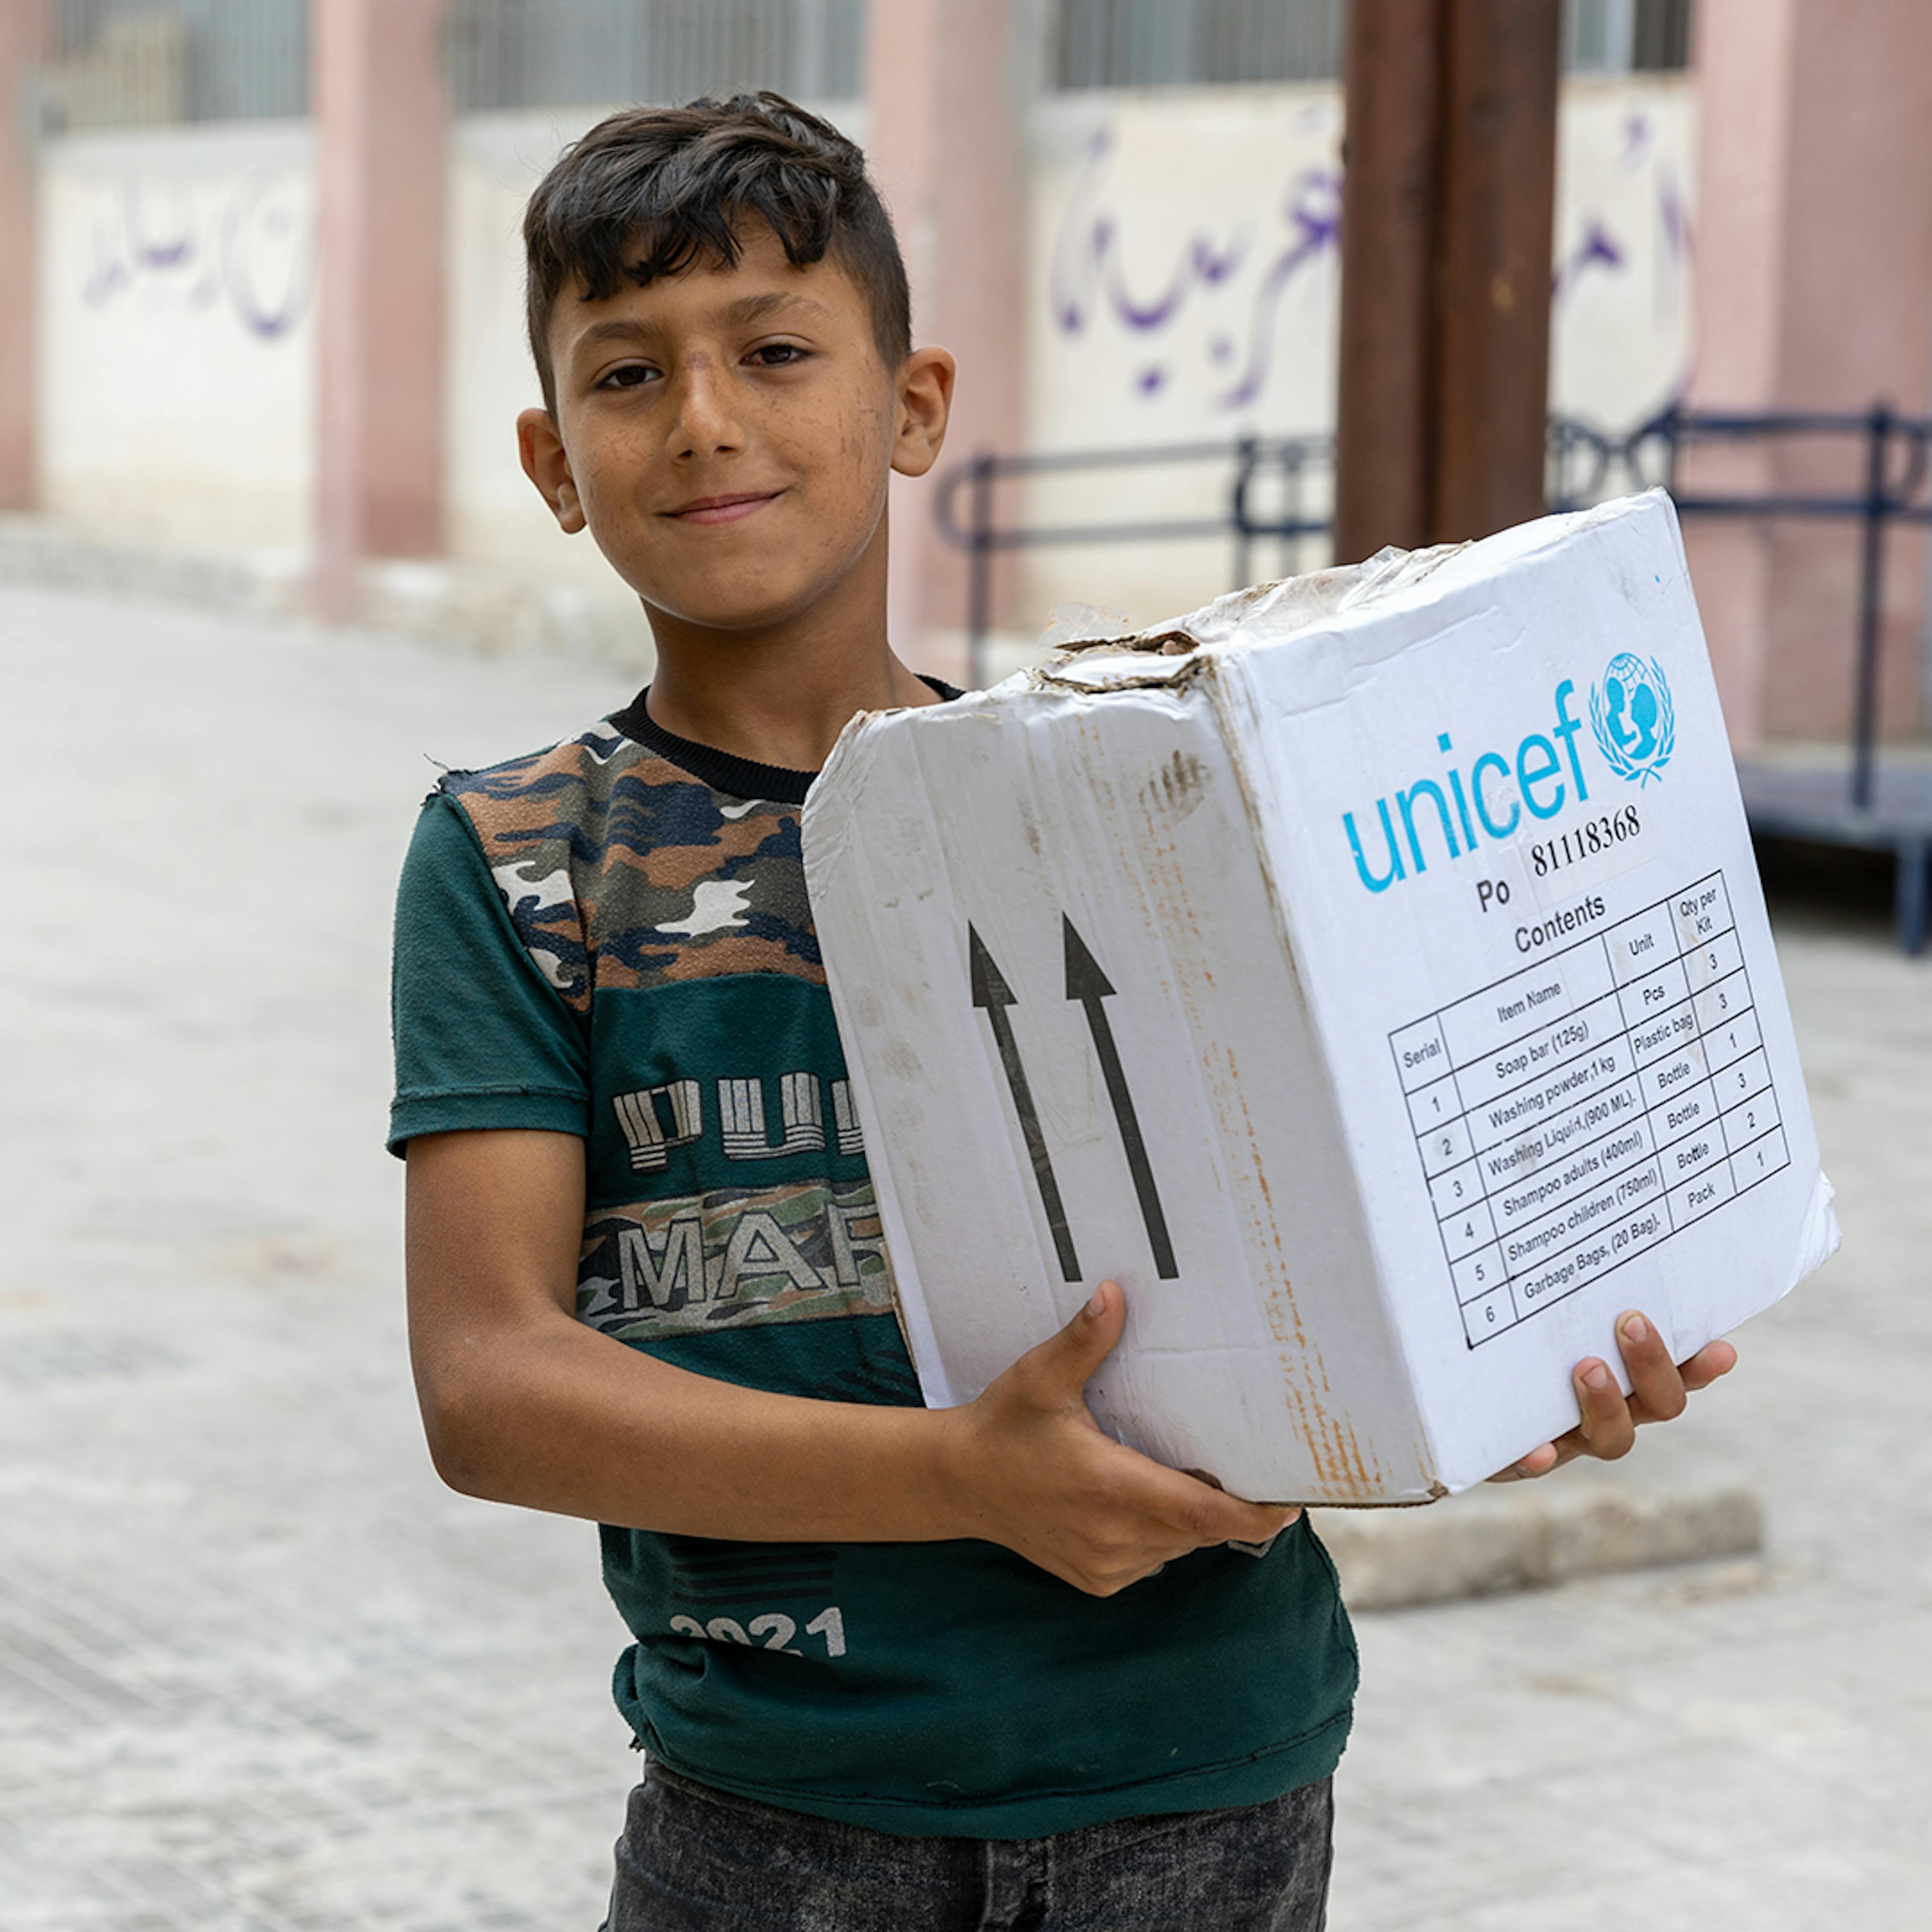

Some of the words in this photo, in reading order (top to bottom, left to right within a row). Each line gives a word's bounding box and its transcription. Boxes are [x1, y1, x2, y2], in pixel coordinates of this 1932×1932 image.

[1342, 679, 1588, 894] unicef
[1477, 877, 1510, 913] Po
[1531, 804, 1641, 877] 81118368
[1679, 899, 1698, 917] Qty
[1699, 889, 1717, 910] per
[1515, 896, 1605, 953] Contents
[1696, 917, 1712, 935] Kit
[1629, 934, 1655, 955] Unit
[1710, 954, 1718, 970] 3
[1497, 999, 1526, 1023] Item
[1526, 983, 1561, 1009] Name
[1643, 986, 1665, 1005] Pcs
[1719, 993, 1727, 1009] 3
[1633, 1026, 1671, 1054] Plastic
[1671, 1014, 1694, 1033] bag
[1730, 1032, 1736, 1048] 1
[1404, 1038, 1441, 1068] Serial
[1496, 1057, 1528, 1079] Soap
[1529, 1043, 1549, 1062] bar
[1551, 1021, 1589, 1054] (125g)
[1657, 1063, 1691, 1089] Bottle
[1738, 1073, 1746, 1088] 3
[1432, 1097, 1440, 1112] 1
[1488, 1094, 1544, 1129] Washing
[1667, 1102, 1700, 1129] Bottle
[1747, 1112, 1755, 1129] 2
[1442, 1139, 1453, 1156] 2
[1488, 1139, 1544, 1176] Washing
[1676, 1142, 1710, 1169] Bottle
[1757, 1151, 1764, 1166] 1
[1503, 1179, 1561, 1217] Shampoo
[1563, 1158, 1600, 1185] adults
[1600, 1131, 1643, 1168] (400ml)
[1453, 1180, 1463, 1197] 3
[1687, 1183, 1716, 1208] Pack
[1508, 1223, 1566, 1262] Shampoo
[1568, 1195, 1614, 1230] children
[1616, 1168, 1657, 1205] (750ml)
[1465, 1223, 1474, 1239] 4
[1476, 1264, 1485, 1281] 5
[1524, 1261, 1575, 1299] Garbage
[1576, 1245, 1610, 1271] Bags,
[1612, 1229, 1629, 1254] (20
[1486, 1306, 1496, 1323] 6
